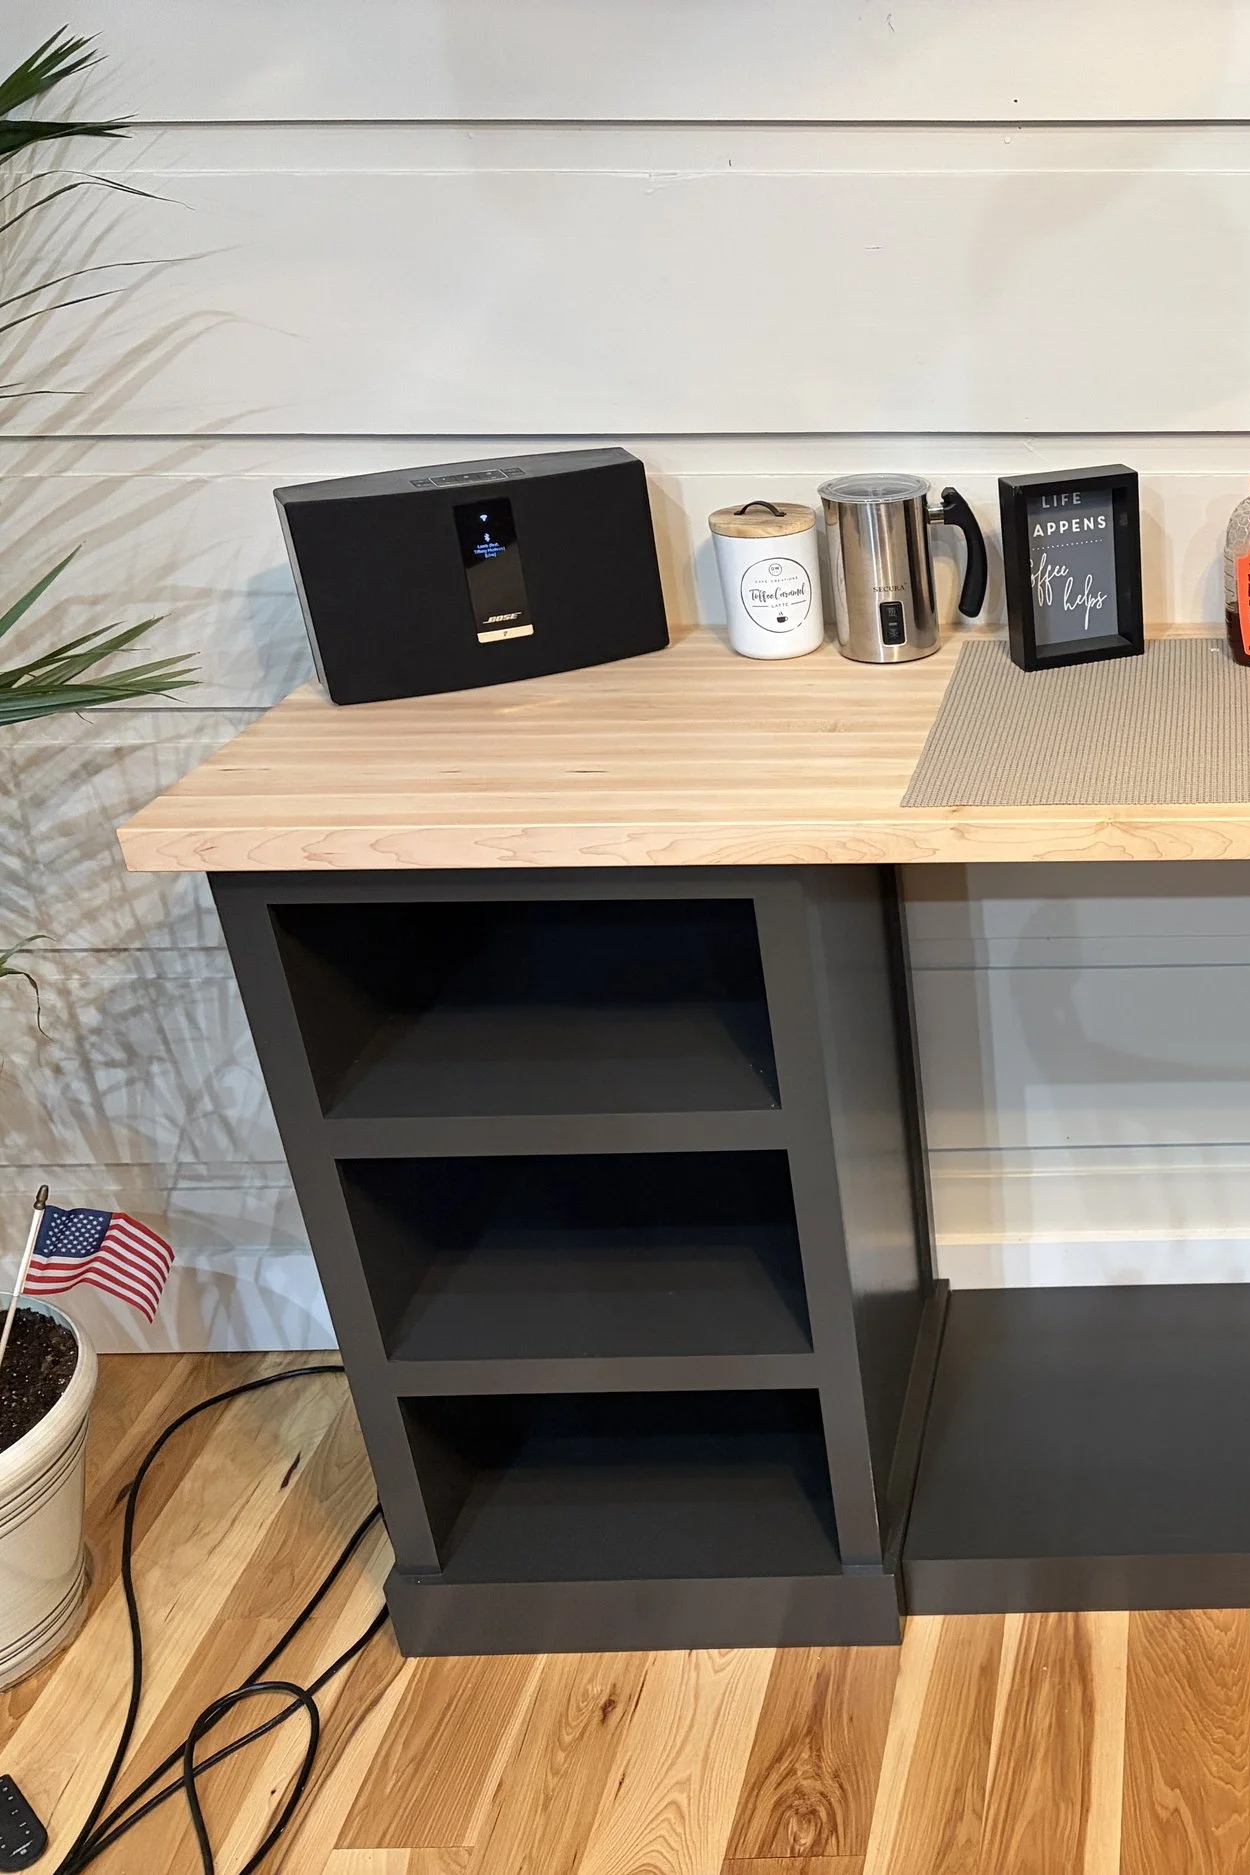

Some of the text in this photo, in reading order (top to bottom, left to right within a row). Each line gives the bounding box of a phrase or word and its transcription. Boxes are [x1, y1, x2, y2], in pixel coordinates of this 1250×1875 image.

[1041, 491, 1082, 508] LIFE
[1033, 515, 1107, 537] APPENS
[872, 585, 905, 593] SECURA
[1030, 553, 1069, 606] offee
[1064, 574, 1107, 630] helps
[485, 612, 520, 623] BOSE
